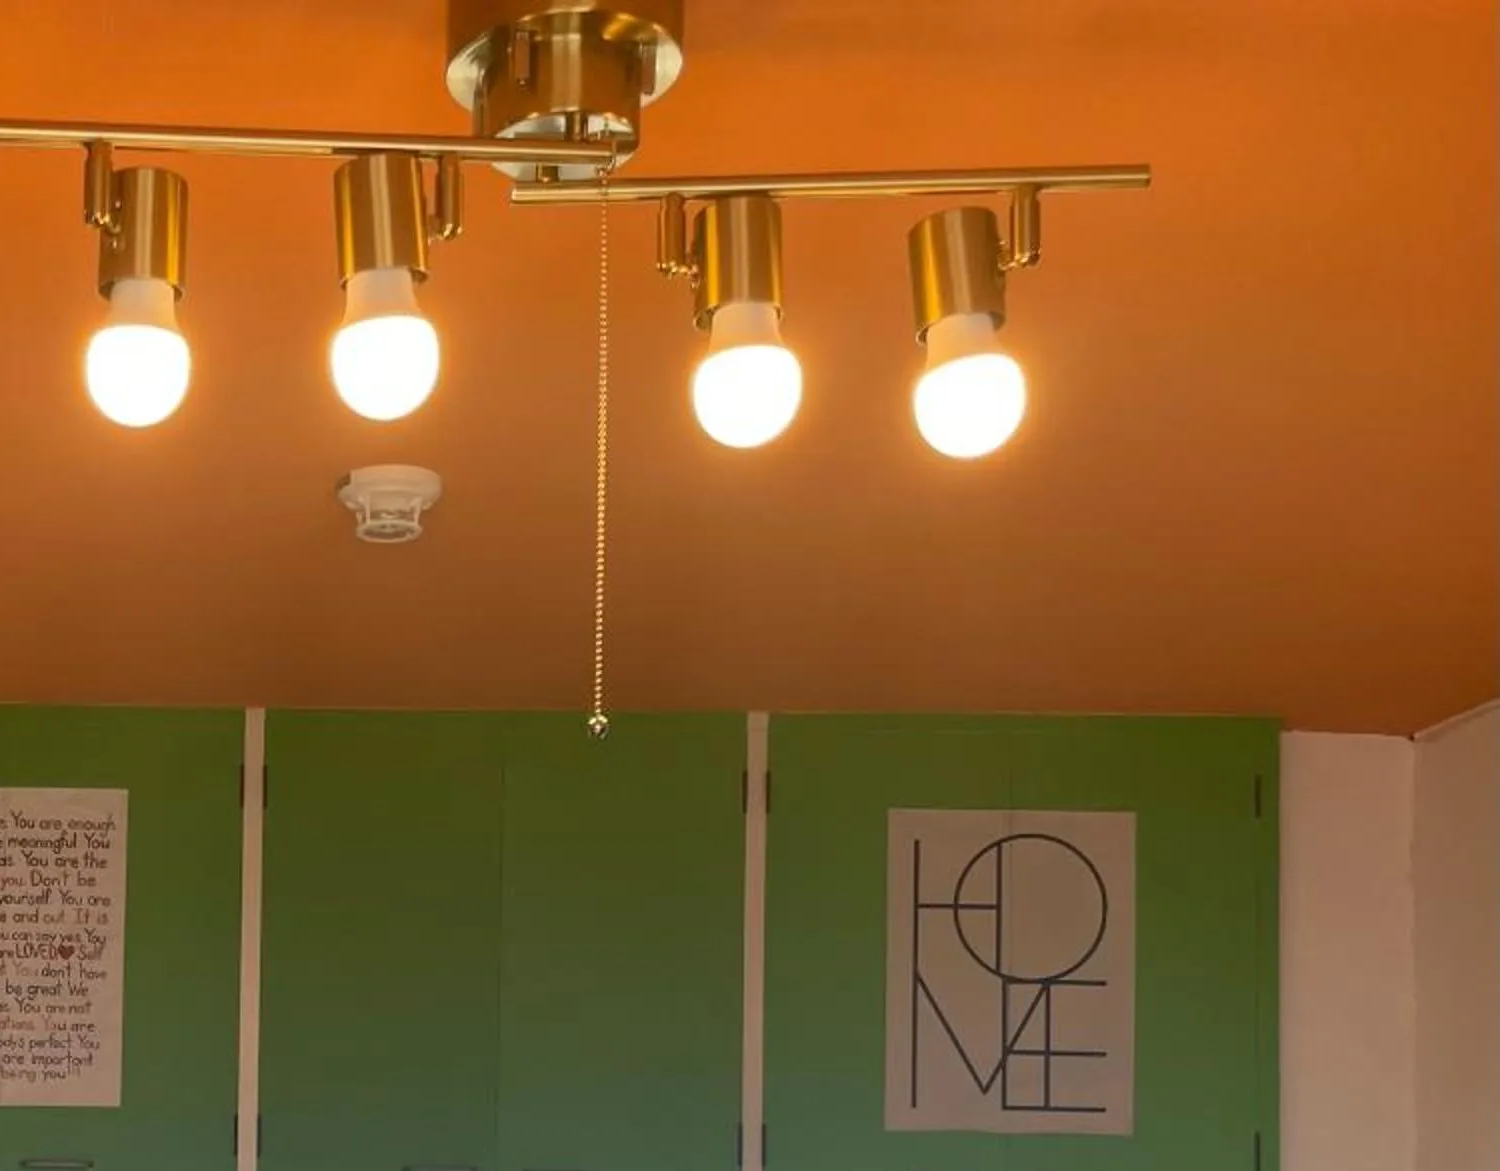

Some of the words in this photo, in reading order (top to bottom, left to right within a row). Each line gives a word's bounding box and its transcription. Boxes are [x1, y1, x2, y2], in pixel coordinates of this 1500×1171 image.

[10, 809, 35, 829] You
[39, 820, 62, 830] are
[84, 832, 111, 848] You
[21, 849, 49, 866] You
[54, 857, 79, 868] are
[83, 851, 108, 868] the
[77, 870, 97, 887] be
[59, 890, 83, 905] You
[88, 895, 111, 906] are
[12, 908, 39, 924] and
[73, 907, 91, 924] It
[97, 910, 109, 924] is
[11, 931, 33, 942] can
[84, 928, 107, 944] You
[79, 962, 108, 980] have
[6, 978, 22, 996] be
[68, 981, 90, 997] We
[14, 997, 41, 1014] You
[46, 1004, 66, 1013] are
[68, 1001, 93, 1014] not
[70, 1022, 97, 1032] are
[78, 1034, 101, 1050] You
[2, 1054, 26, 1065] are
[0, 1064, 37, 1083] being
